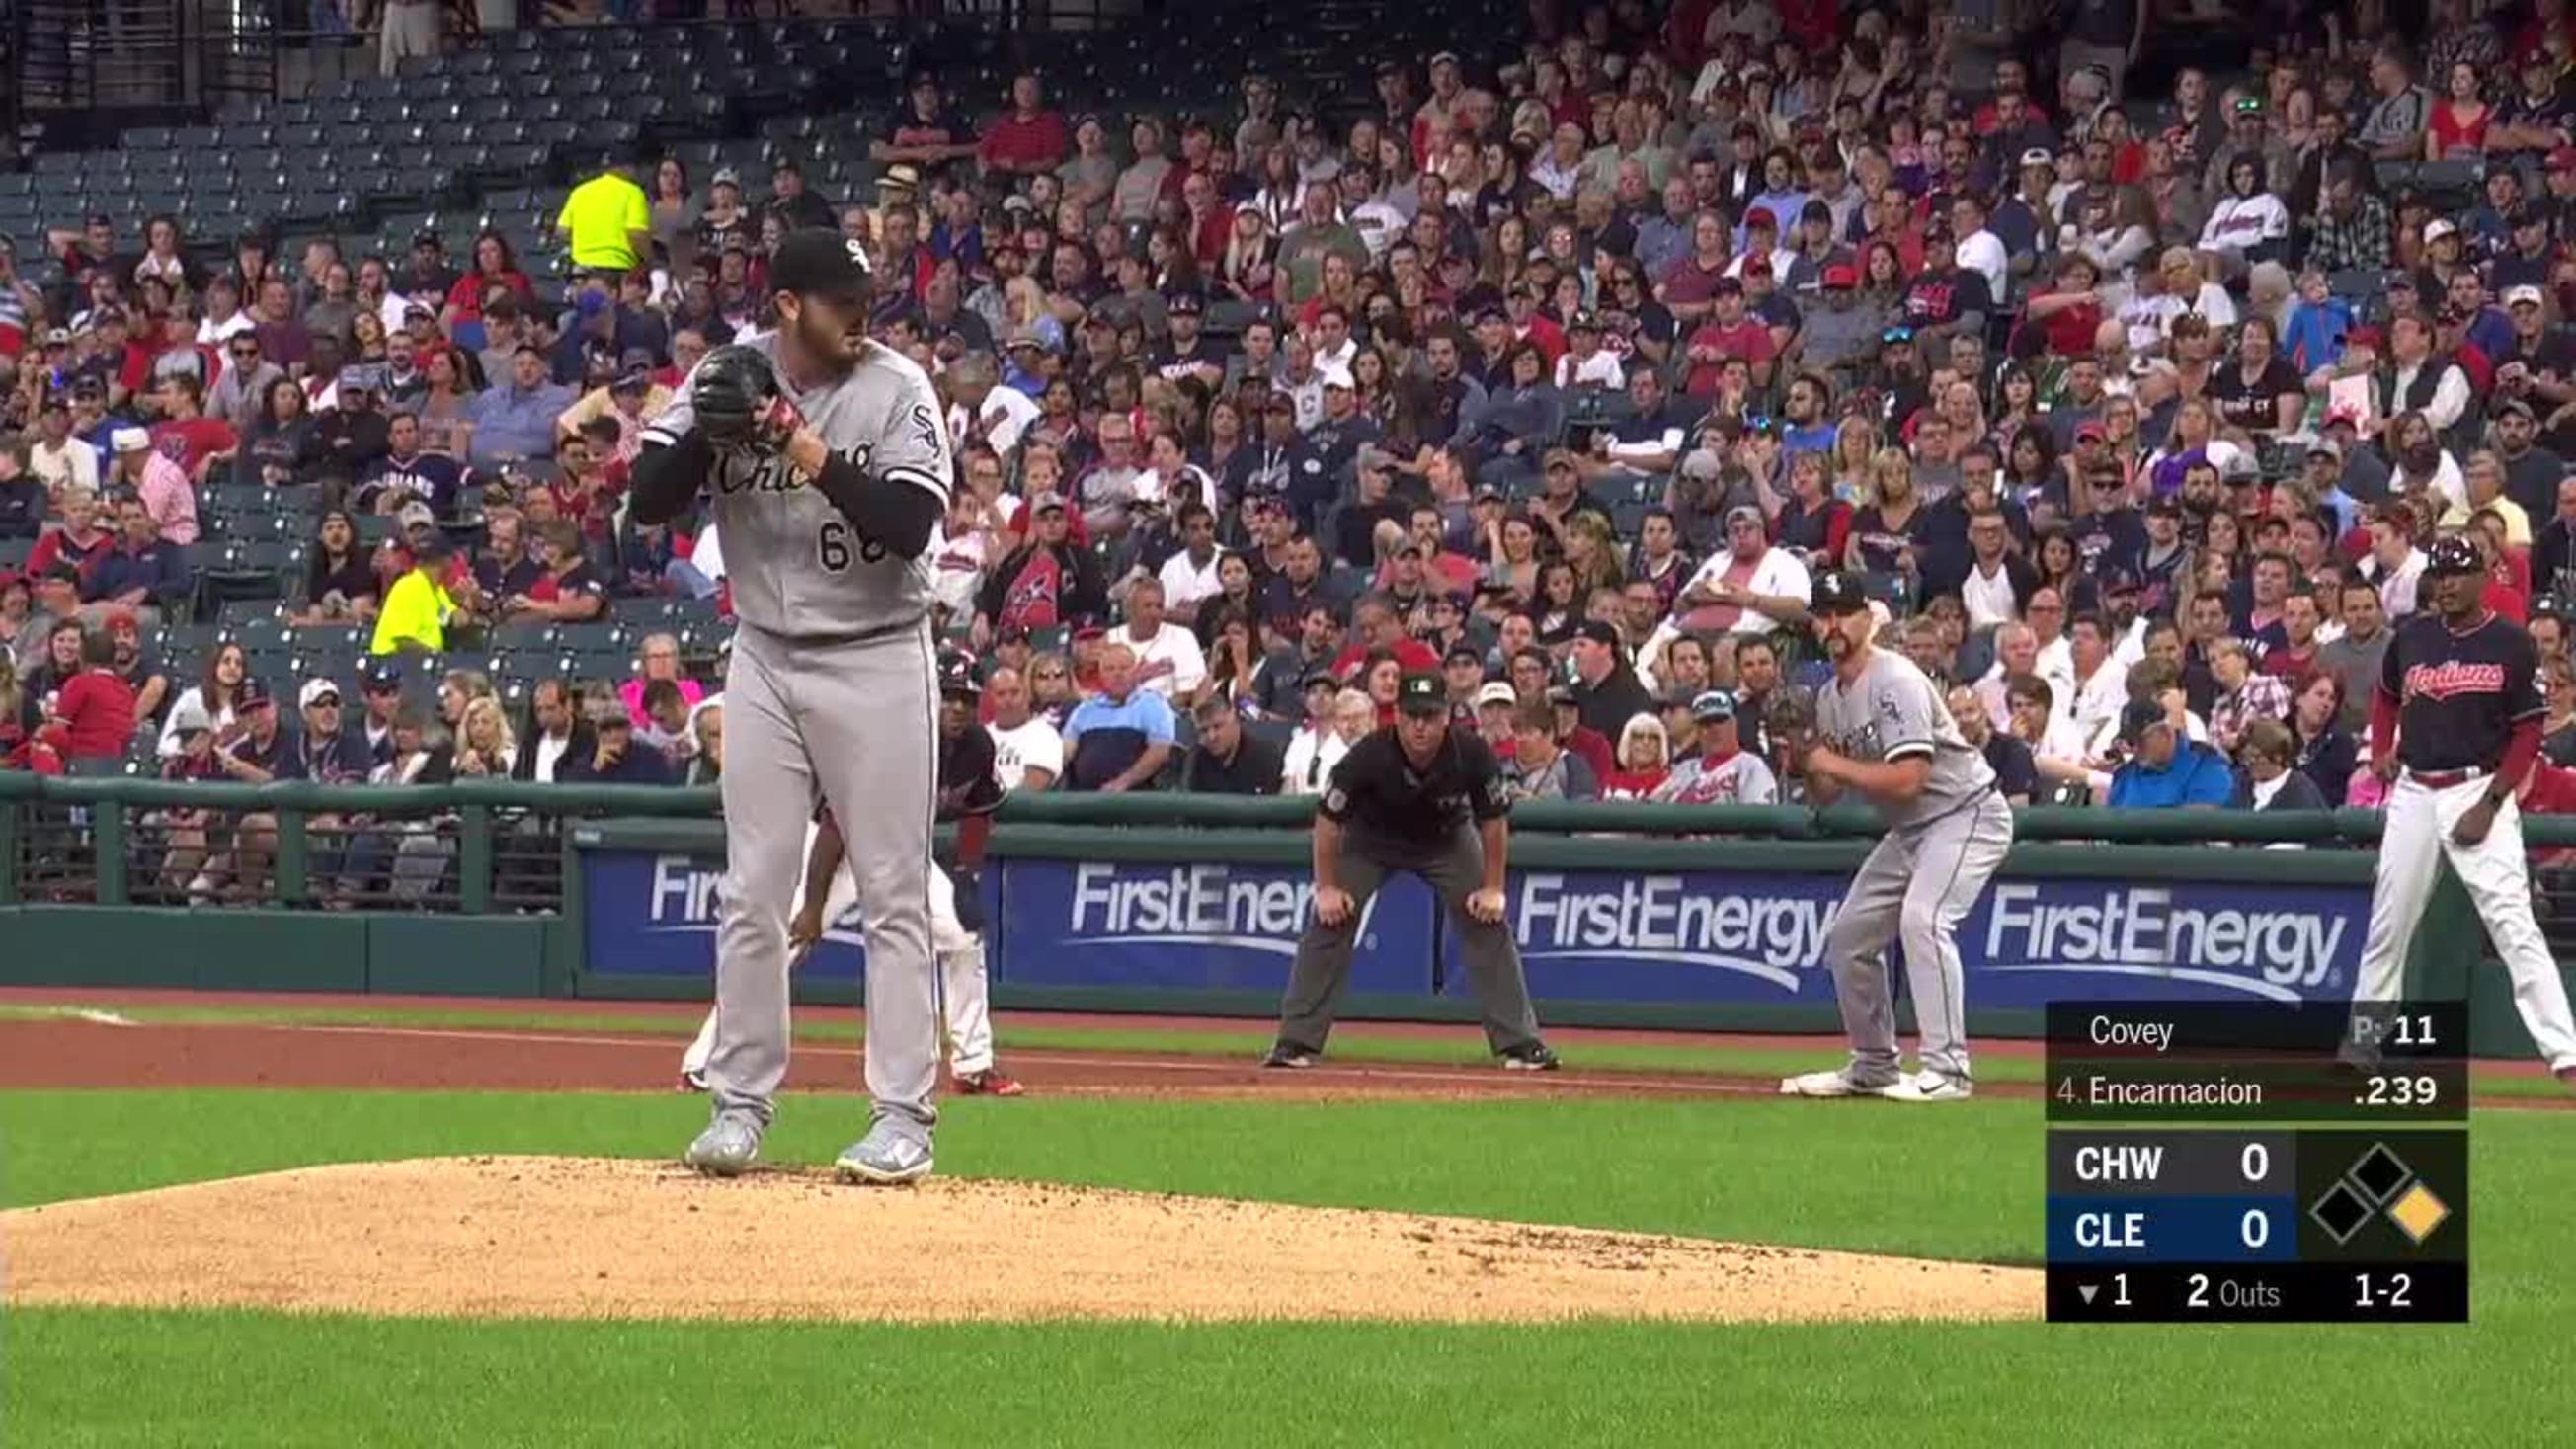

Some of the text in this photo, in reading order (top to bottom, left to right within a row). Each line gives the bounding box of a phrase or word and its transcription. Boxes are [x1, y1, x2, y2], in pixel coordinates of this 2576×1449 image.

[1070, 862, 1377, 950] FirstEner
[1516, 874, 1839, 968] FirstEnergy
[1984, 885, 2348, 987] FirstEnergy
